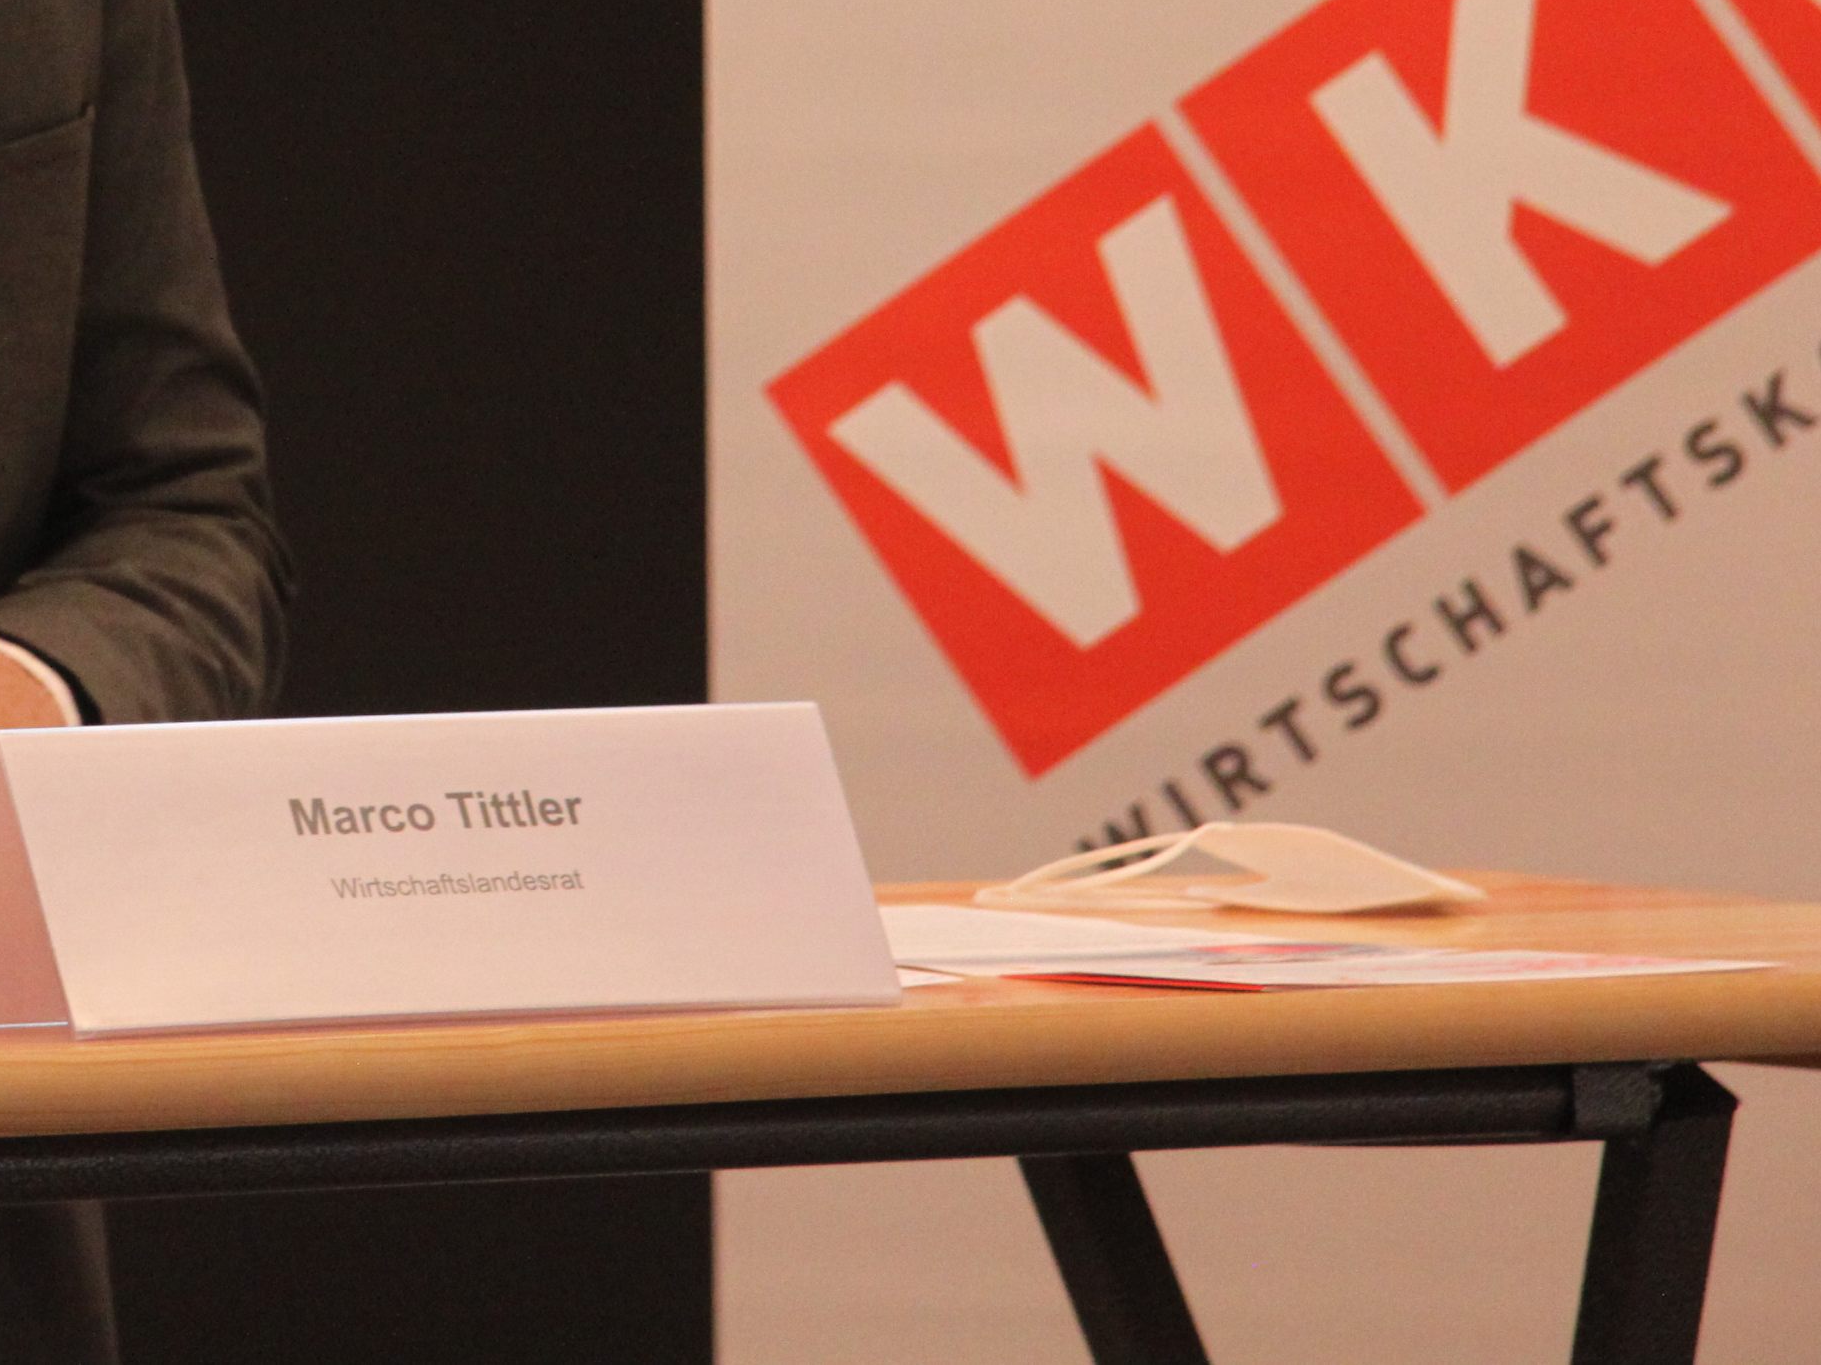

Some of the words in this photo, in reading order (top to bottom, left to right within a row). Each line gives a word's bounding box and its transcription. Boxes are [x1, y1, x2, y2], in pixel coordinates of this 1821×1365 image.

[1078, 340, 1821, 872] WIRTSCHAFTSK
[288, 798, 436, 836] Marco
[445, 789, 582, 829] Tittler
[330, 869, 584, 899] Wirtschaftslandesrat
